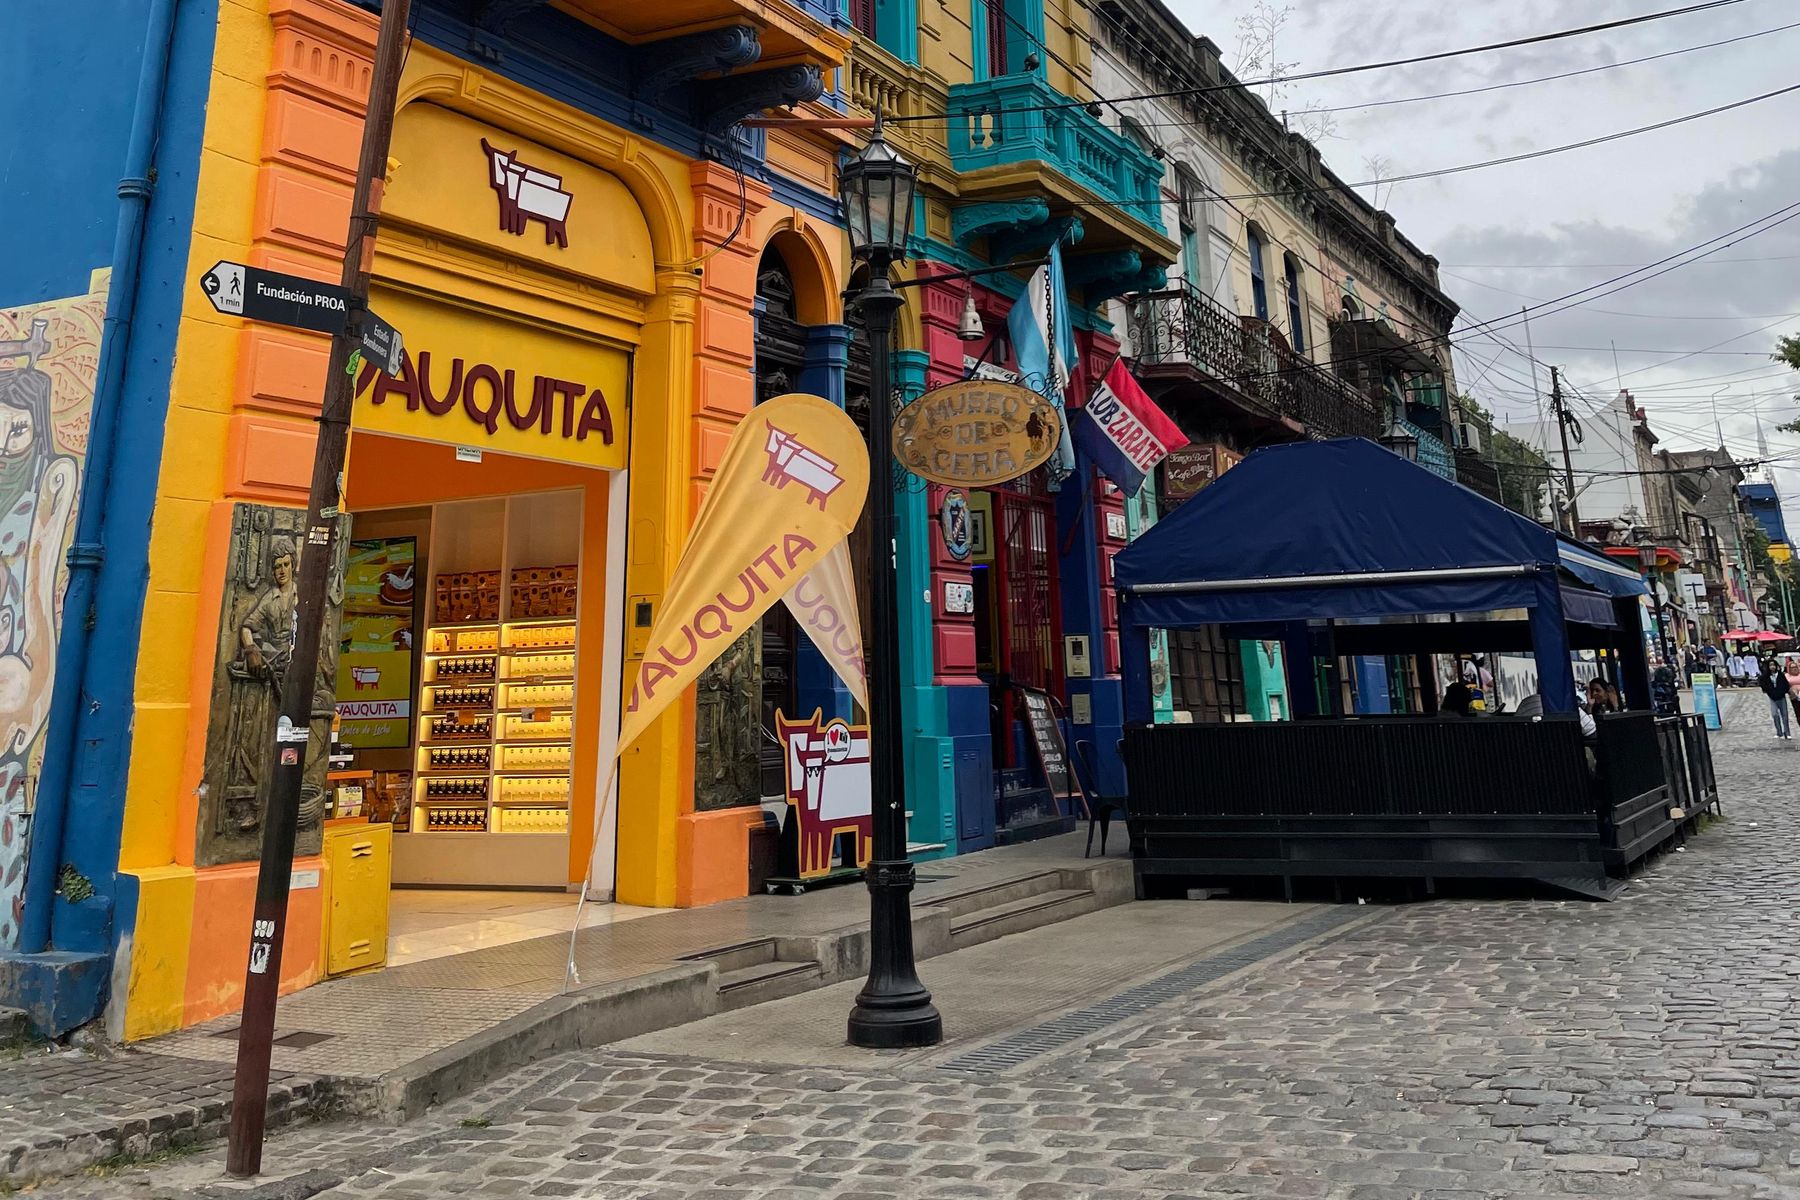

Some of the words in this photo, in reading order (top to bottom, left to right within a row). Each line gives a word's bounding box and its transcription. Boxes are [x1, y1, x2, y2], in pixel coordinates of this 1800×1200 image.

[219, 296, 224, 304] 1
[226, 298, 240, 307] min
[256, 282, 313, 305] Fundación
[315, 294, 346, 312] PROA
[374, 324, 390, 344] Estadio
[922, 391, 1019, 428] MUSEO
[956, 420, 988, 445] DE
[1107, 411, 1164, 471] ZARATE
[931, 448, 1016, 477] CERA
[1170, 453, 1192, 465] Tango
